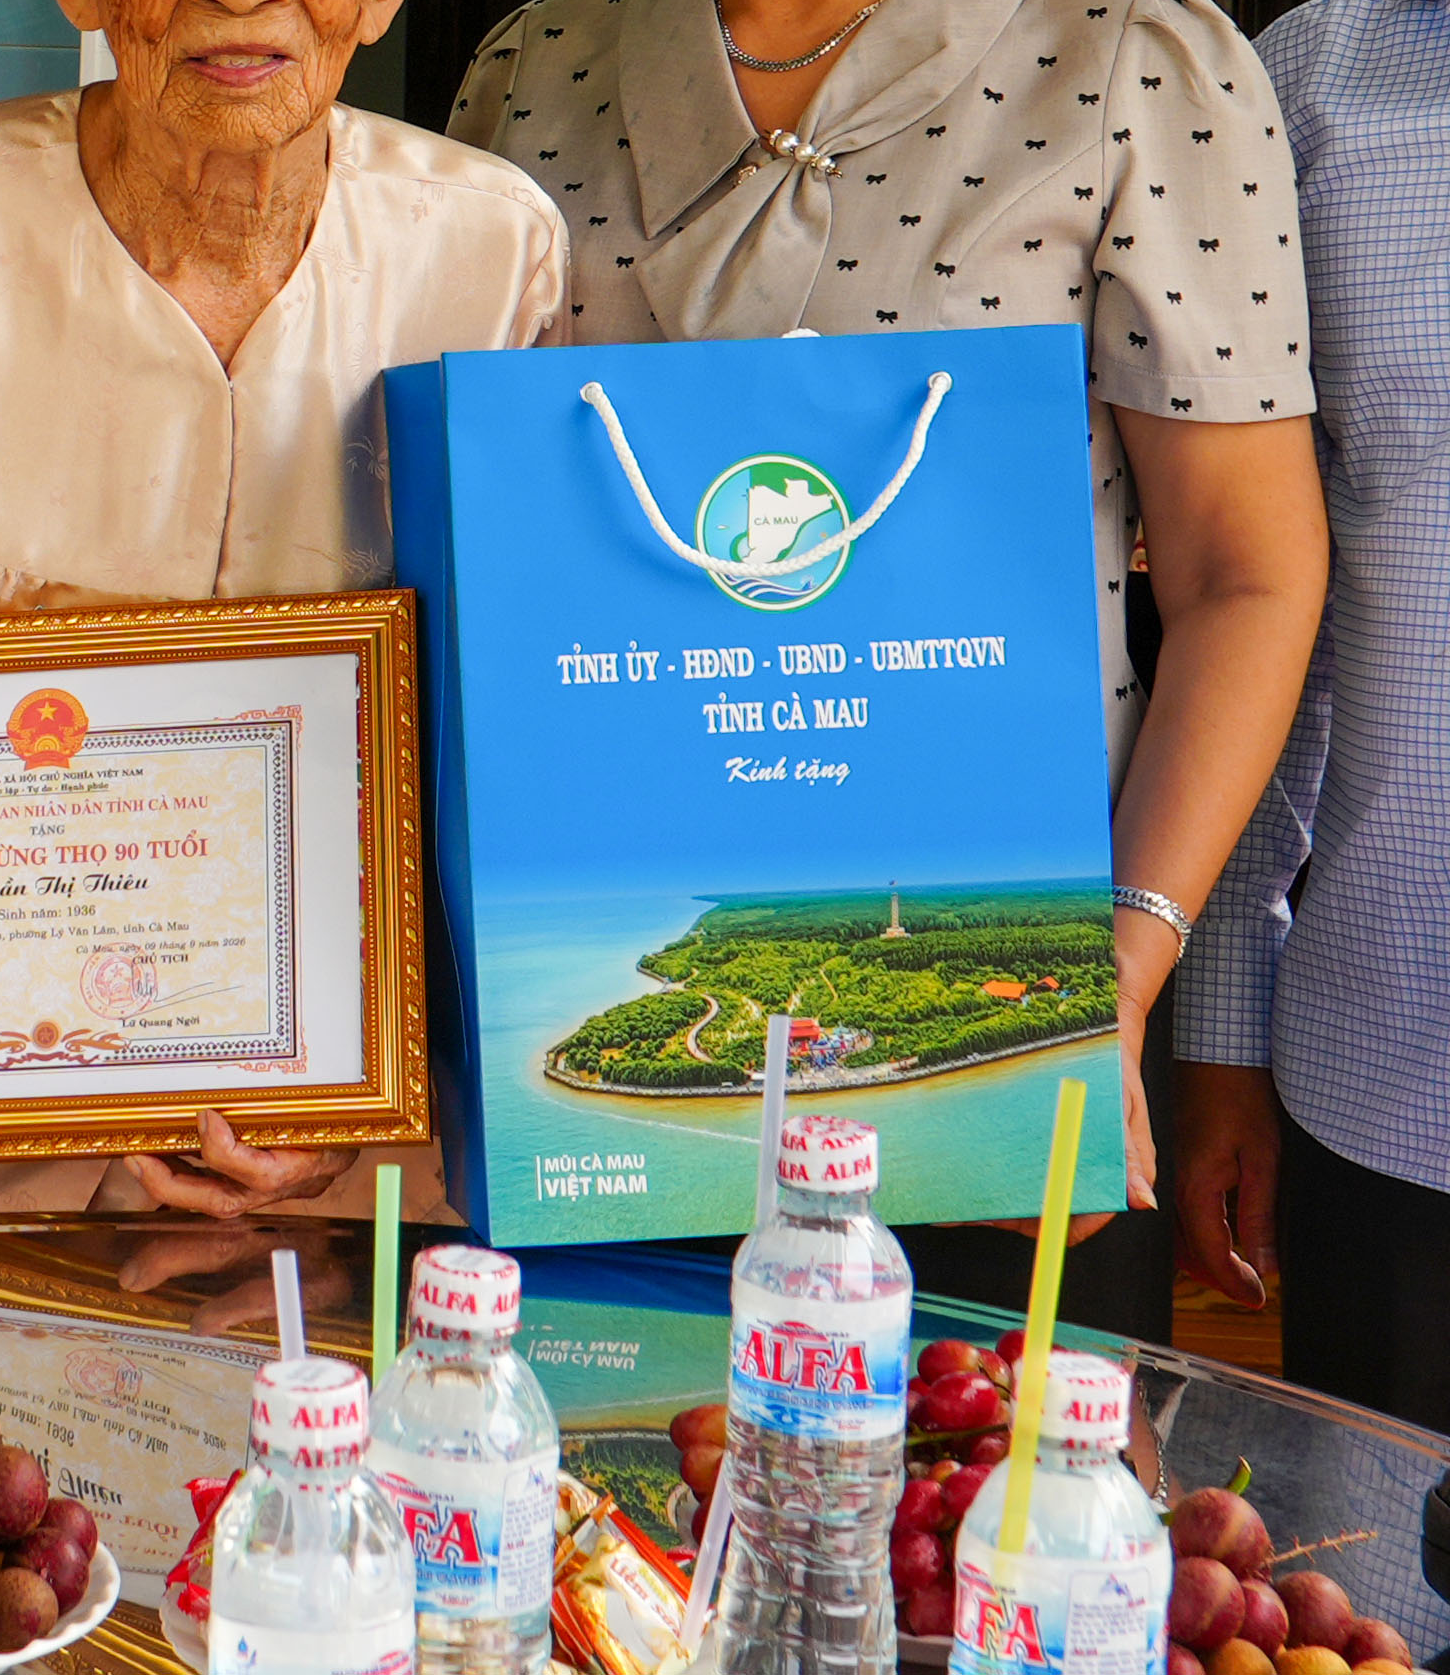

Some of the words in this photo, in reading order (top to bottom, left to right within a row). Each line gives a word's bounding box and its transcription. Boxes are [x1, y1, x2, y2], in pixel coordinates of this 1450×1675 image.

[753, 516, 770, 526] CÀ
[773, 515, 798, 525] MAU
[557, 642, 620, 685] TỈNH
[626, 640, 660, 682] ỦY
[682, 647, 755, 680] HĐND
[777, 642, 847, 676] UBND
[869, 636, 1007, 672] UBMTTQVN
[703, 692, 765, 734] TỈNH
[772, 692, 808, 732] CÀ
[812, 697, 870, 729] MAU
[19, 774, 37, 783] HỘI
[39, 772, 60, 782] CHỦ
[63, 770, 94, 780] NGHĨA
[97, 769, 119, 779] VIỆT
[122, 768, 144, 777] NAM
[724, 754, 788, 785] Kính
[794, 755, 851, 787] tặng
[24, 801, 67, 818] NHÂN
[71, 798, 103, 815] DÂN
[106, 797, 144, 814] TỈNH
[148, 794, 169, 811] CÀ
[173, 795, 209, 810] MAU
[30, 824, 65, 838] TẶNG
[55, 843, 107, 868] THỌ
[115, 840, 140, 862] 90
[146, 829, 209, 860] TUỔI
[33, 875, 75, 899] Thị
[31, 907, 62, 920] năm:
[67, 904, 96, 917] 1936
[68, 926, 89, 937] Văn
[148, 922, 163, 932] Cà
[166, 921, 190, 932] Mau
[222, 937, 246, 947] 2026
[161, 954, 188, 964] TỊCH
[139, 1017, 173, 1028] Quang
[544, 1154, 577, 1173] MŨI
[580, 1152, 604, 1172] CÀ
[606, 1153, 645, 1170] MAU
[821, 1155, 873, 1182] ALFA
[544, 1173, 592, 1202] VIỆT
[597, 1174, 648, 1196] NAM
[417, 1279, 479, 1316] ALFA
[738, 1325, 876, 1396] ALFA
[291, 1401, 360, 1430] ALFA
